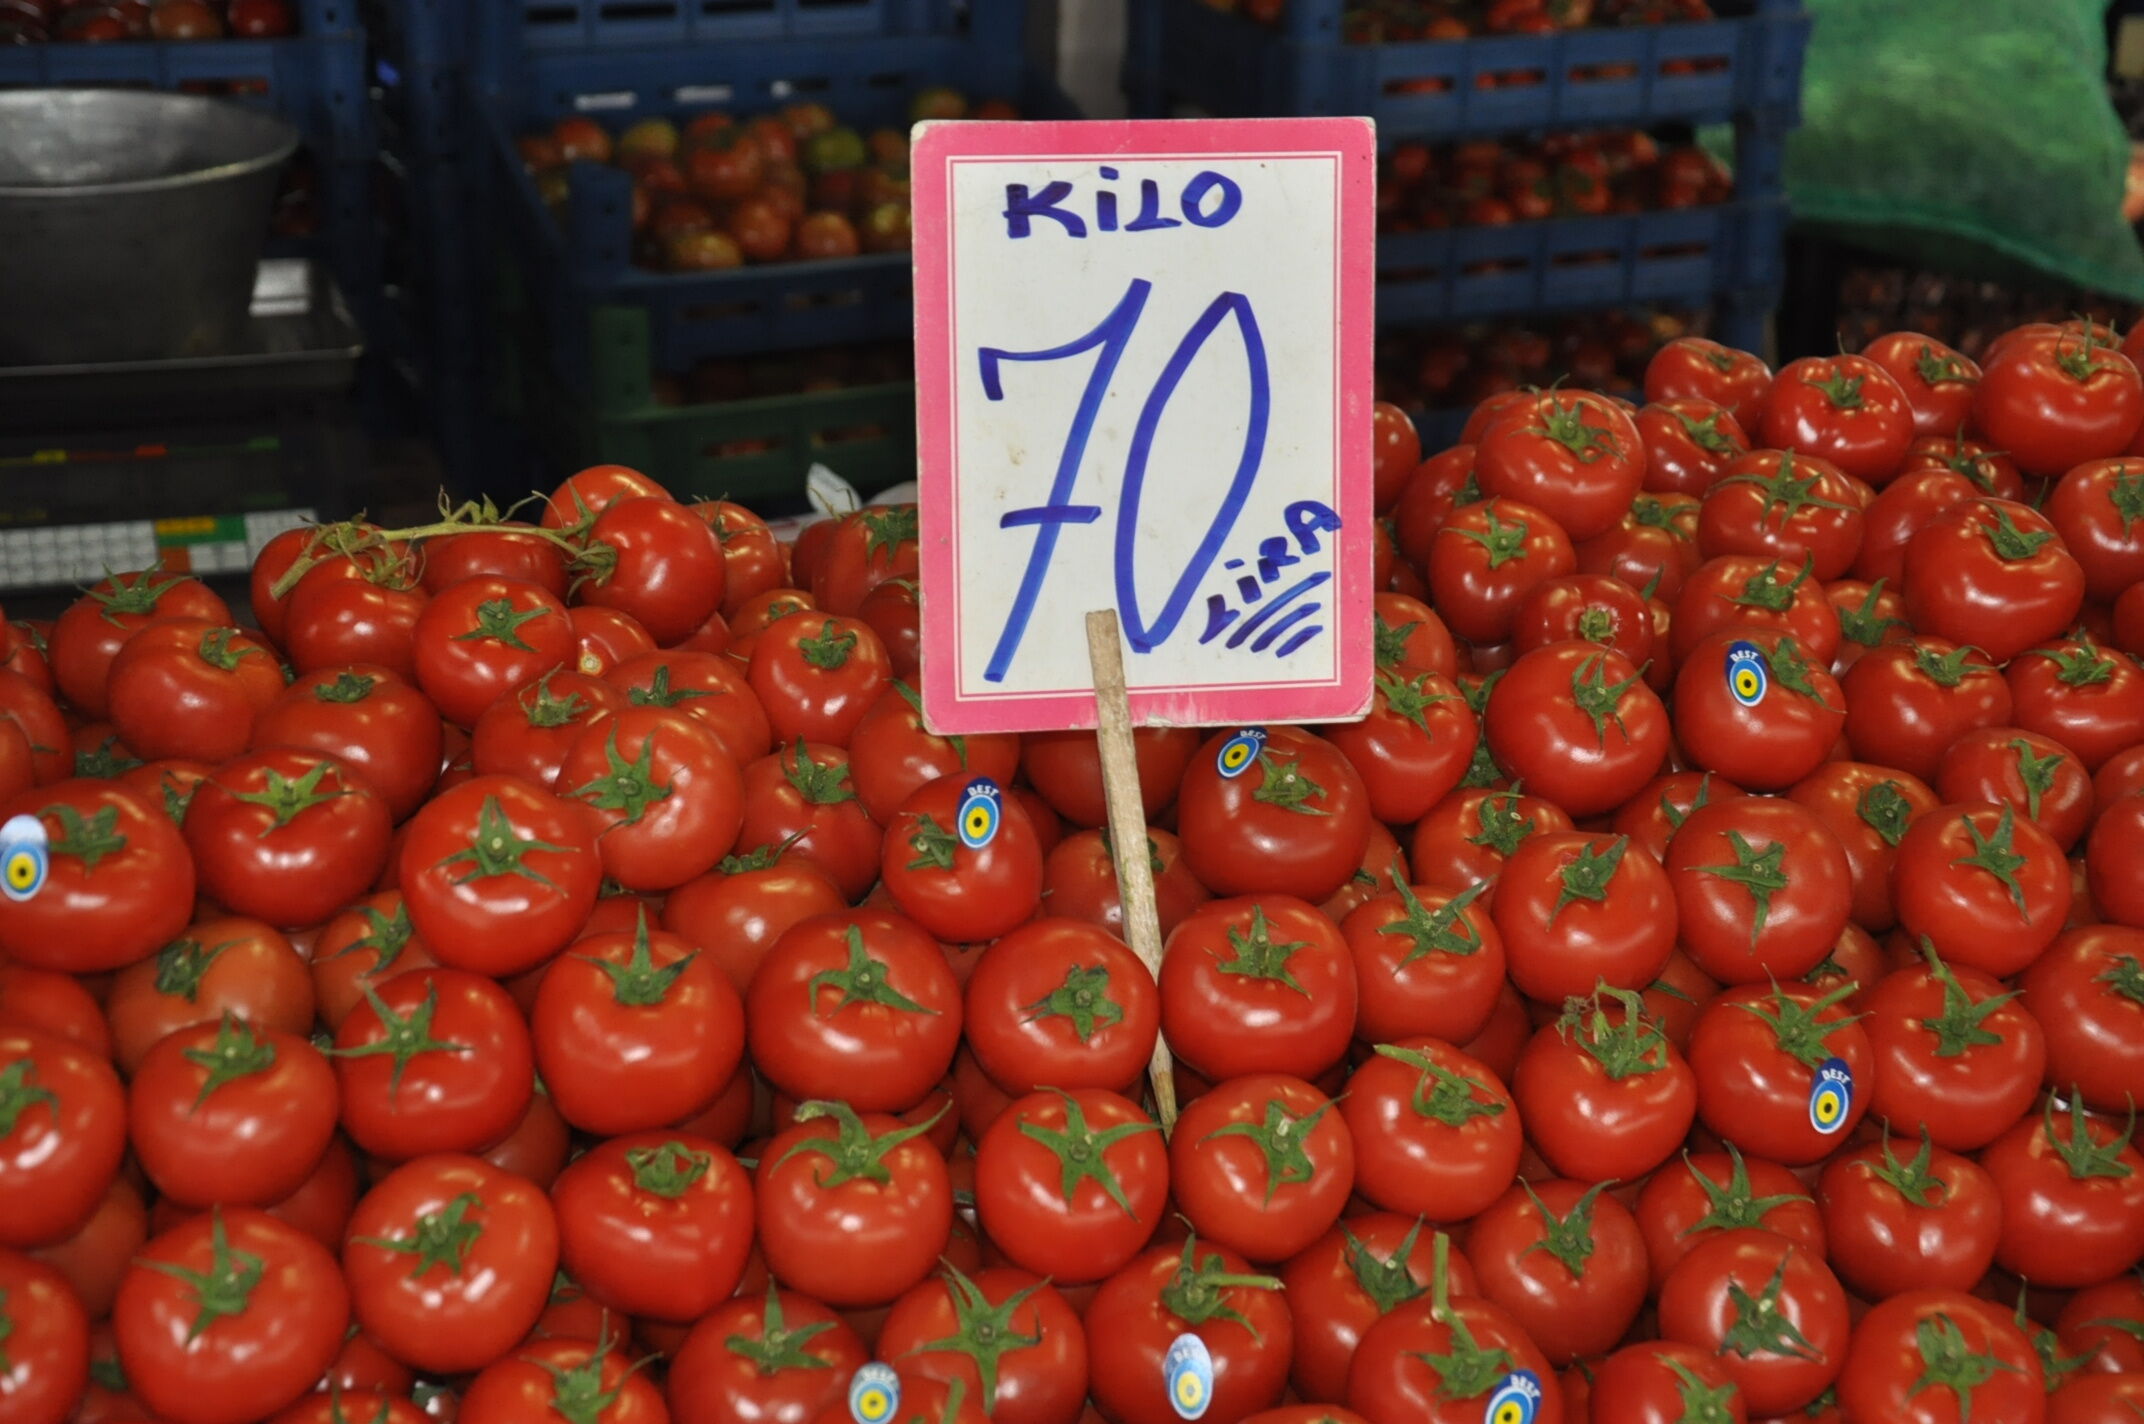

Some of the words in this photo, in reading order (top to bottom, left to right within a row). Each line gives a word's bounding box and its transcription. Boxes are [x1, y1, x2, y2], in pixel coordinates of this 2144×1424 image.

[977, 279, 1270, 681] 70
[1730, 650, 1758, 663] BEST
[1240, 729, 1266, 741] BEST
[967, 784, 999, 797] BEST
[1821, 1068, 1851, 1085] BEST
[1511, 1374, 1541, 1398] BEST
